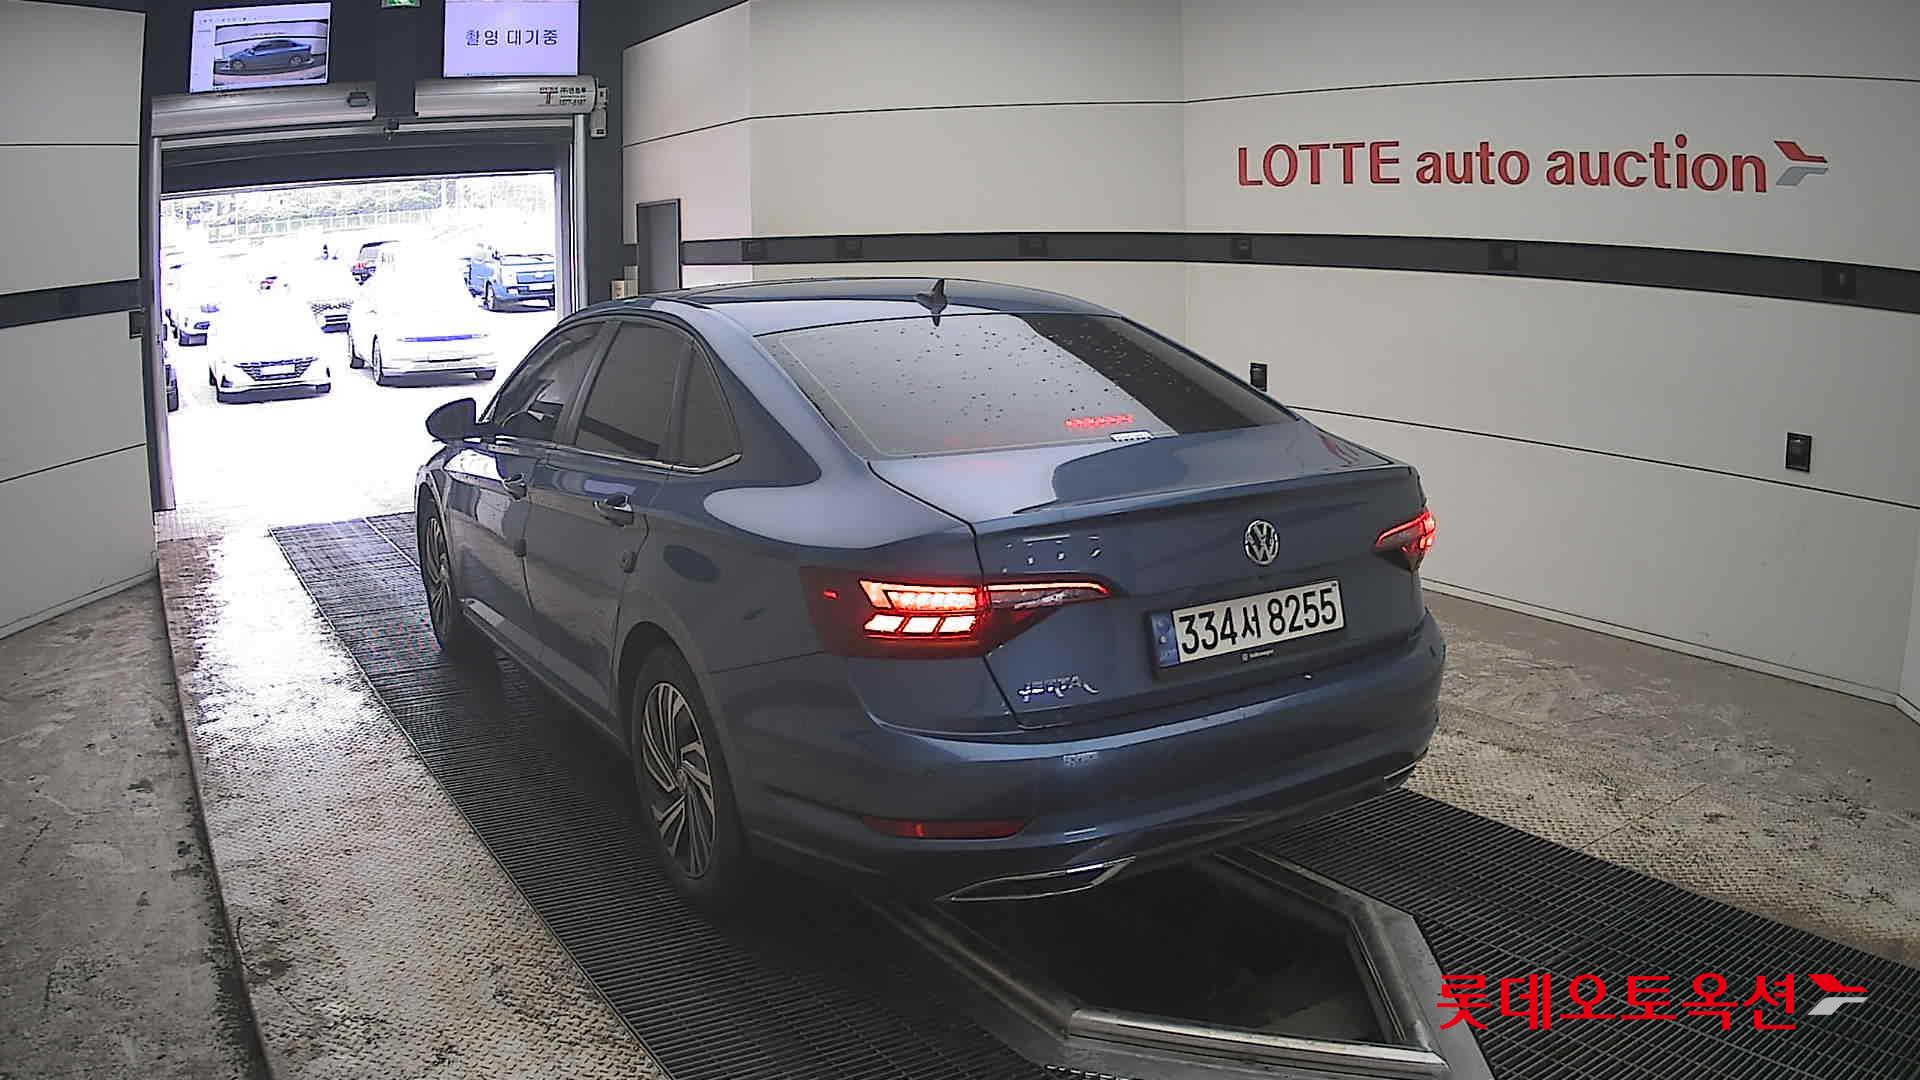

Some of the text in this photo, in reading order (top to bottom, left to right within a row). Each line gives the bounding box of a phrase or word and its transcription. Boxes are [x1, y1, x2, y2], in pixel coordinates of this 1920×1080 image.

[506, 29, 558, 46] 대기중
[1239, 134, 1767, 192] LOTTE auto auction
